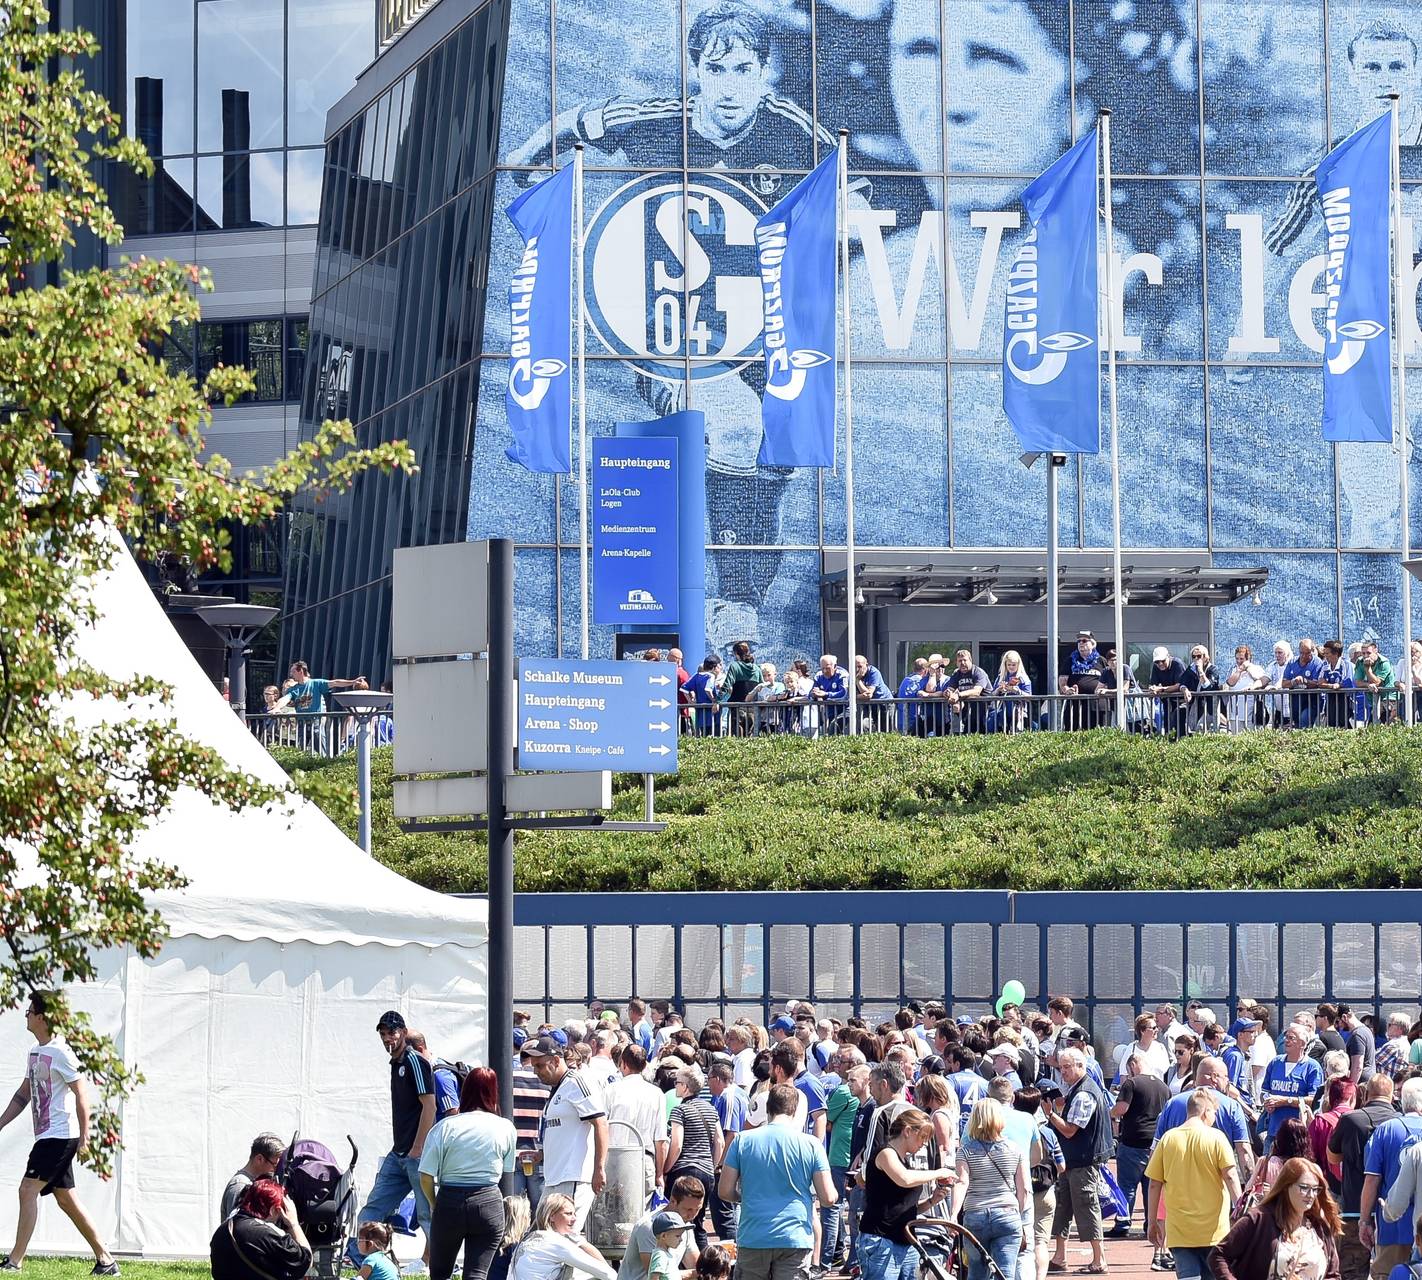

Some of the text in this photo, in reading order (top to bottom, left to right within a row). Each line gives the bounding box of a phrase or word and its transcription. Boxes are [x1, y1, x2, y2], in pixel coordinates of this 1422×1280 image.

[847, 210, 1163, 352] Wr
[600, 457, 670, 469] Haupteingang
[601, 500, 622, 508] Logen
[601, 525, 656, 533] Medienzentrum
[601, 549, 651, 558] Arena-Kapelle
[524, 670, 623, 685] Schalke Museum
[524, 694, 605, 710] Haupteingang
[524, 717, 560, 730] Arena
[569, 718, 598, 733] Shop
[524, 741, 624, 756] Kuzorra Kneipe Café
[1271, 1080, 1291, 1092] SCHALKE
